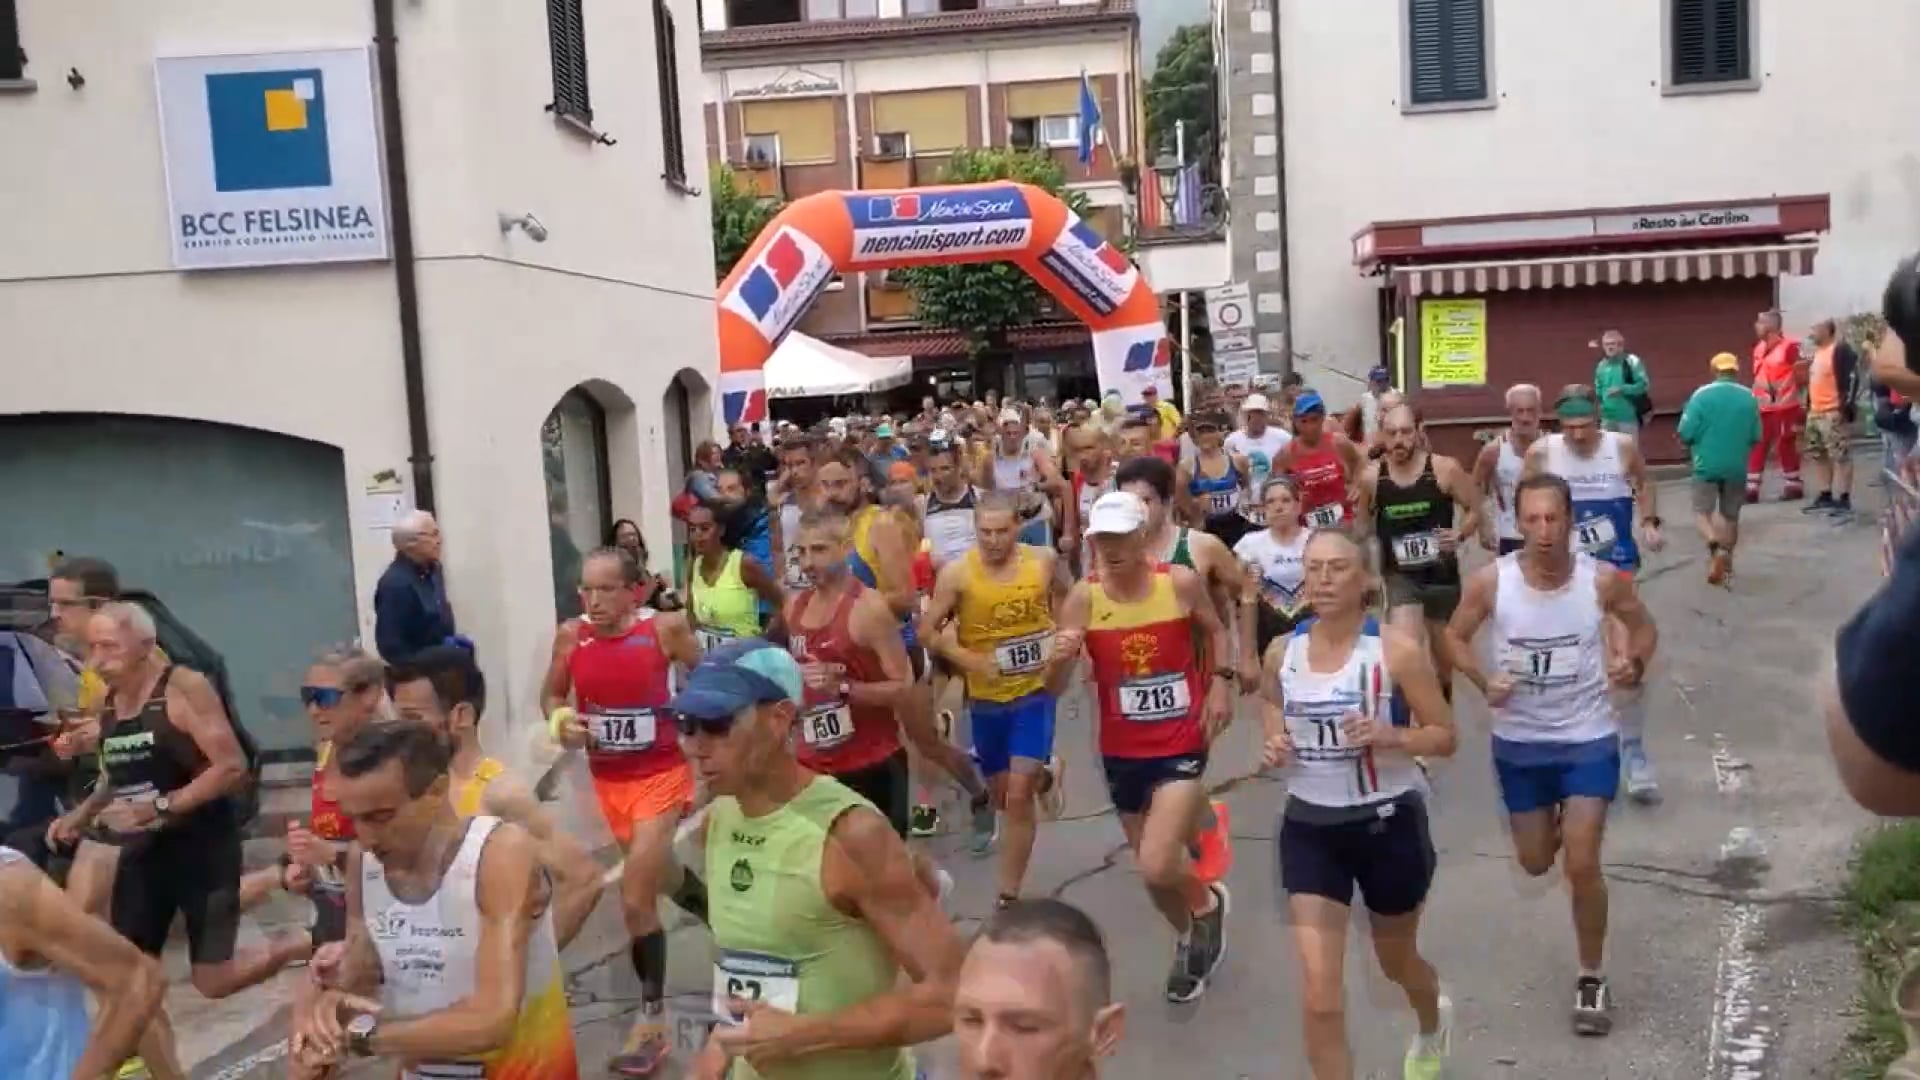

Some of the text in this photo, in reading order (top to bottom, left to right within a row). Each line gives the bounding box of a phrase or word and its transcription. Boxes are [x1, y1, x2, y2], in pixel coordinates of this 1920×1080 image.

[181, 205, 374, 237] BCC FELSINEA
[1640, 217, 1677, 229] Resto
[1699, 210, 1750, 226] Carlino
[860, 226, 1026, 253] nencinisport.com
[1008, 643, 1041, 667] 158
[1531, 651, 1553, 676] 17
[1136, 685, 1175, 712] 213
[602, 719, 637, 741] 174
[1309, 718, 1339, 746] 71
